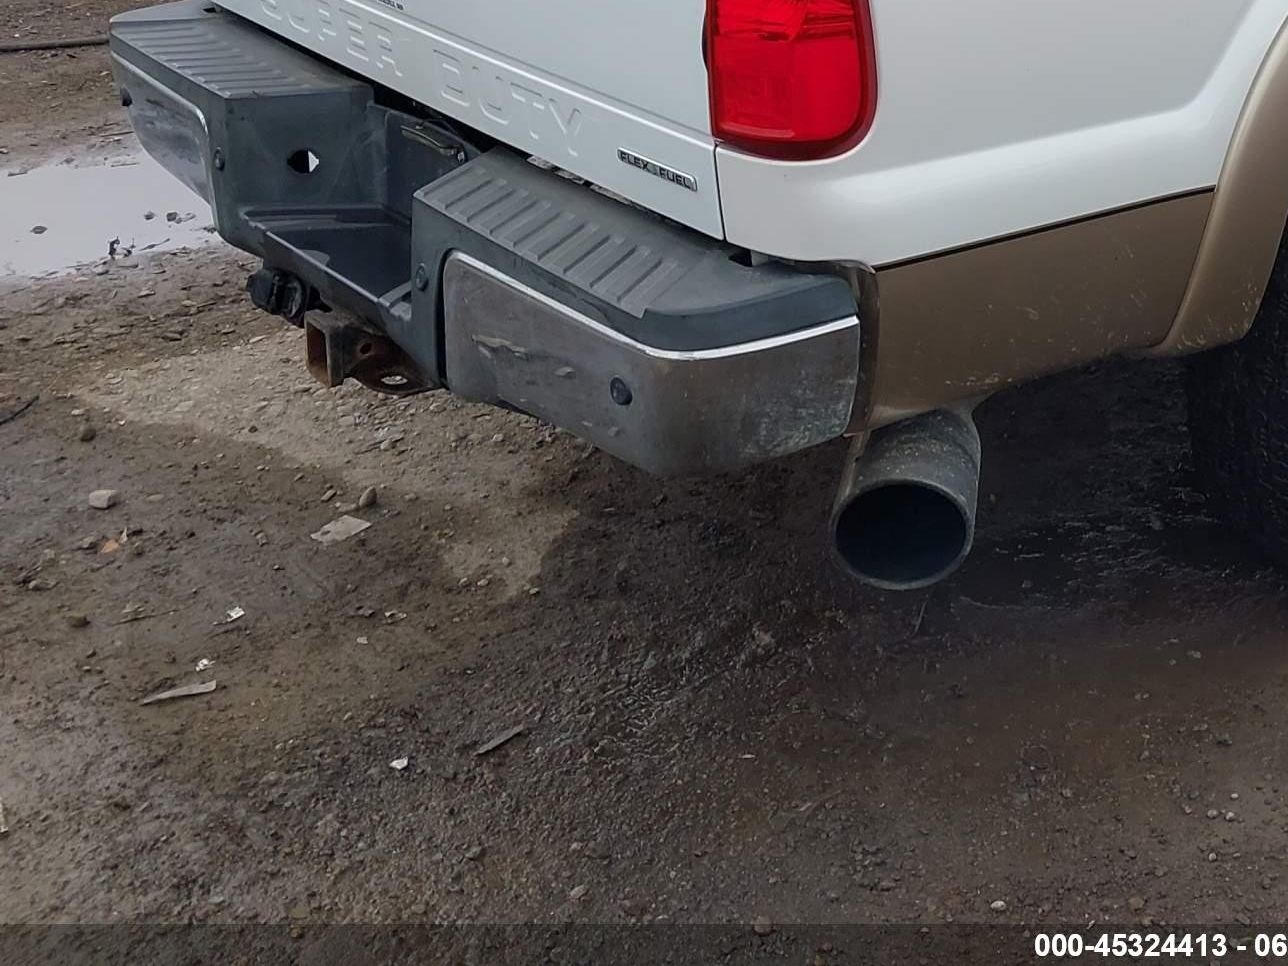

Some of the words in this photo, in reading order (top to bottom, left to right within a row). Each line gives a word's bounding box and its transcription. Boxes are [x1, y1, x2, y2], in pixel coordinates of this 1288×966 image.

[433, 48, 583, 157] DUTY
[620, 149, 648, 171] FLEX
[659, 165, 693, 190] FUEL
